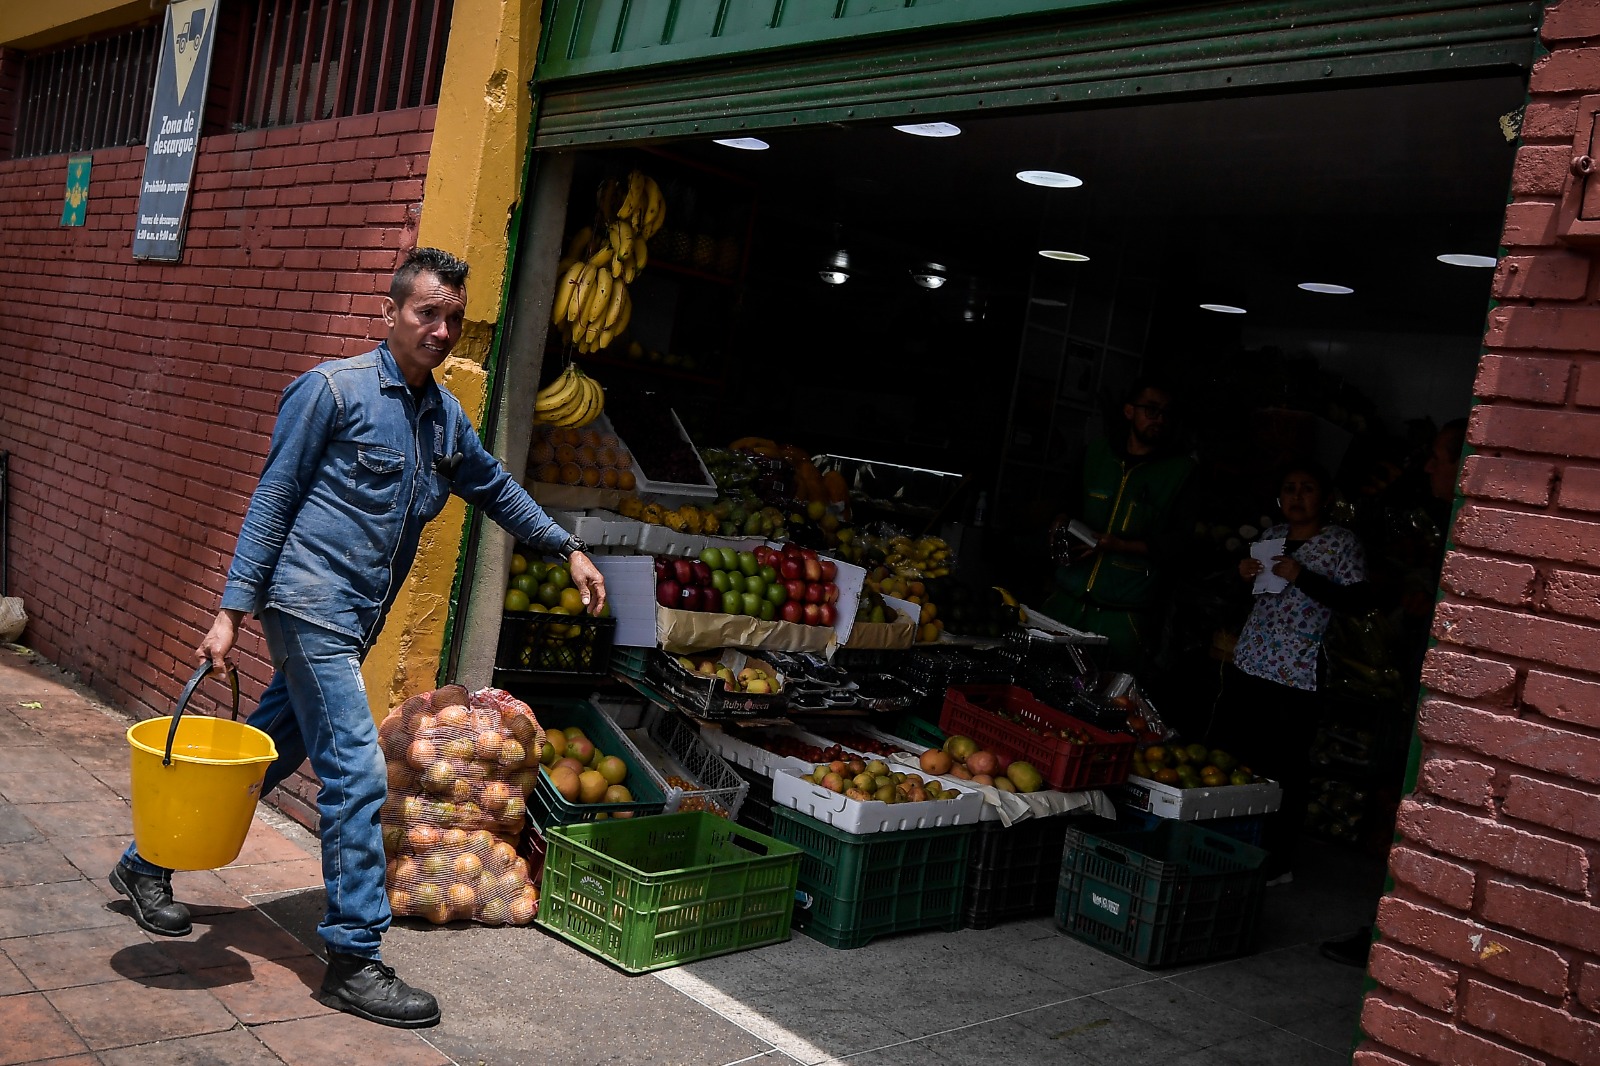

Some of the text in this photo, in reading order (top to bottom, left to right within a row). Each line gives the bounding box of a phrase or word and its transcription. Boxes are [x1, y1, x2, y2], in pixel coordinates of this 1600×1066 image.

[161, 111, 195, 135] Zona de
[153, 134, 194, 157] descargue
[144, 180, 167, 193] Prohibido
[141, 213, 180, 227] Horas de descargue
